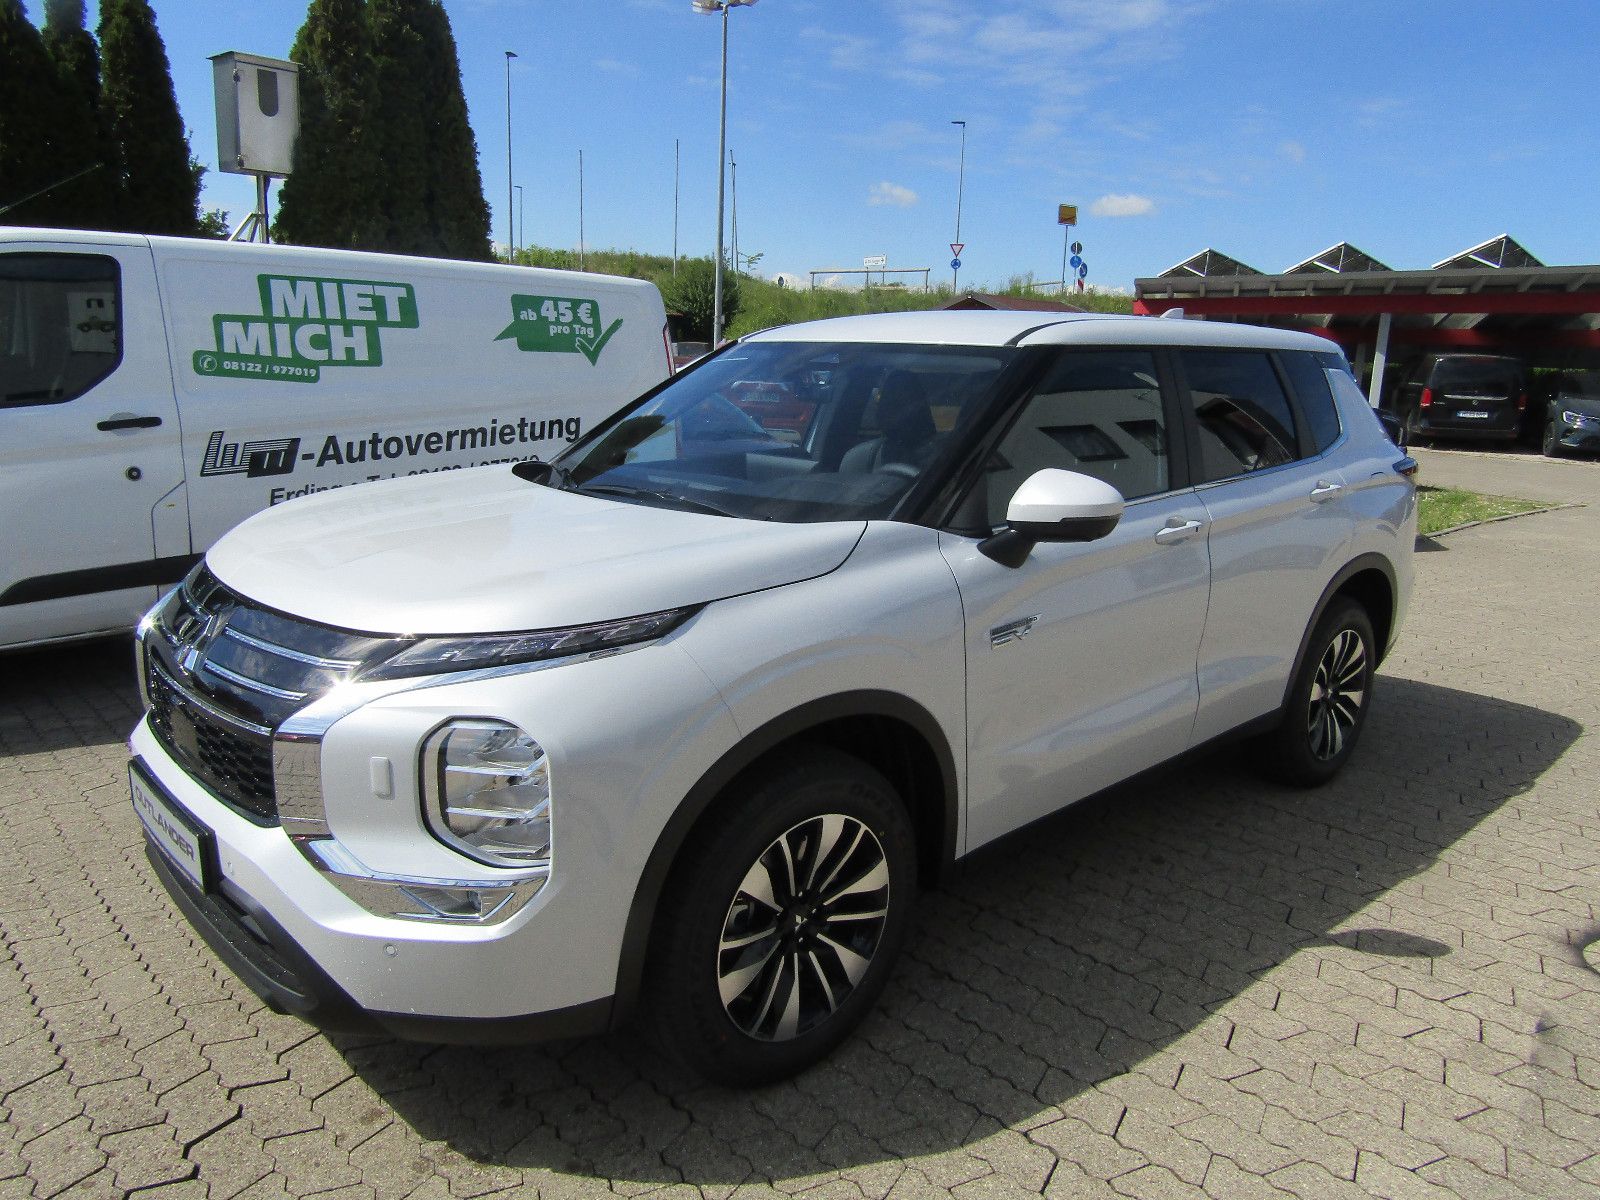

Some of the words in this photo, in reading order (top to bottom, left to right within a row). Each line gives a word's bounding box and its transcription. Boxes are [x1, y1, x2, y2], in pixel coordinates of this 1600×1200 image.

[269, 278, 408, 322] MIET
[519, 308, 538, 321] ab
[540, 299, 574, 323] 45
[576, 302, 594, 325] €
[221, 321, 370, 361] MICH
[549, 325, 571, 337] pro
[572, 324, 595, 339] Tag
[223, 360, 262, 373] 08122
[265, 364, 270, 374] /
[272, 364, 318, 377] 977019
[134, 784, 195, 861] OUTLANDER
